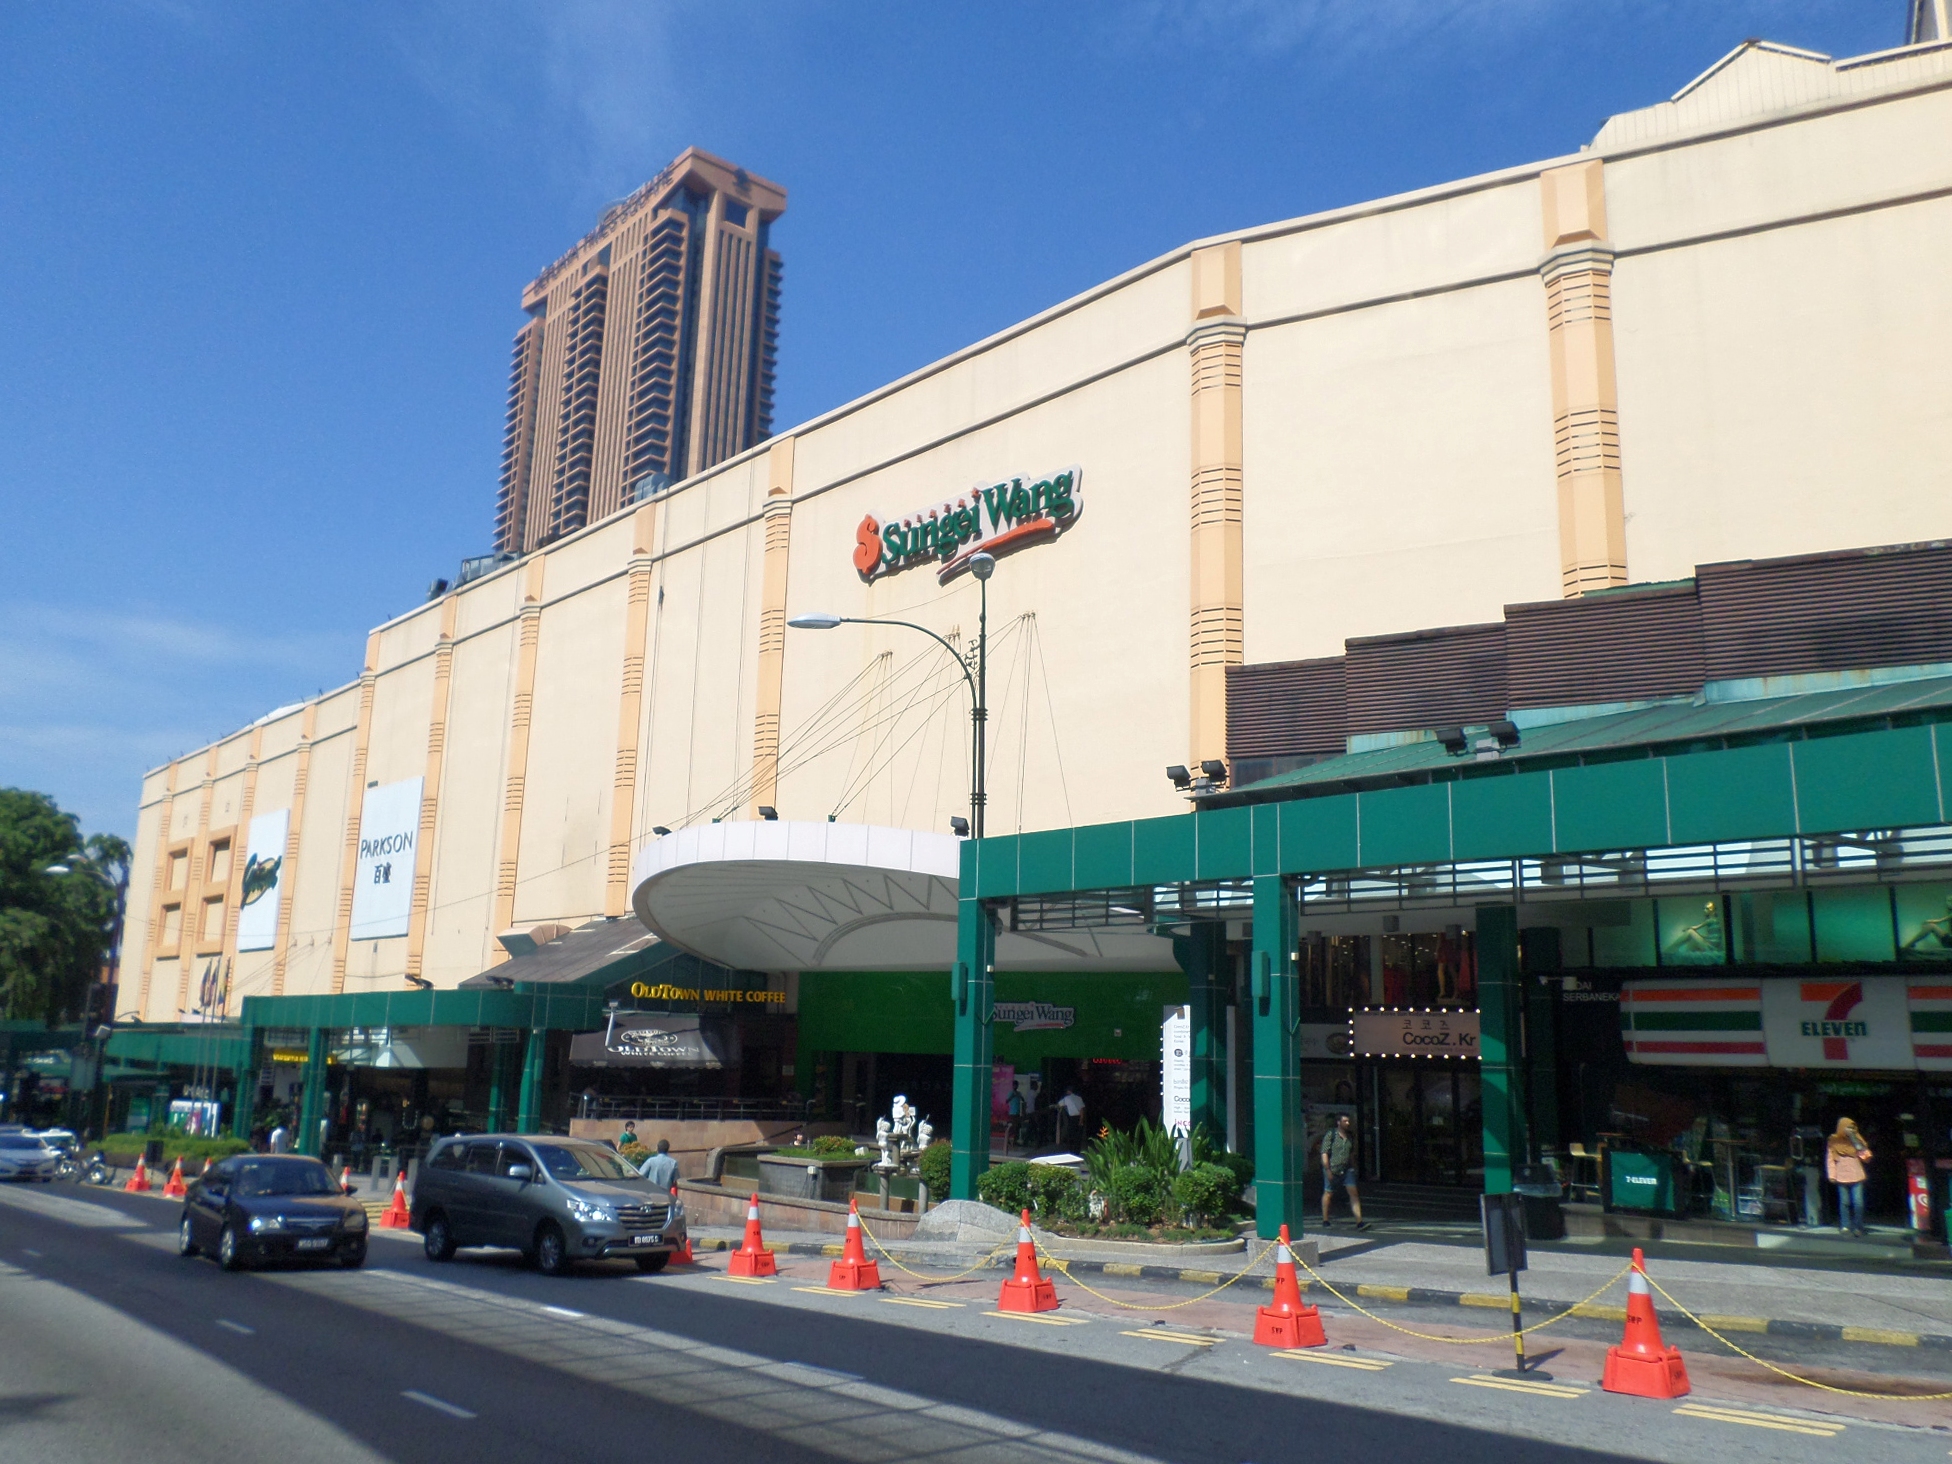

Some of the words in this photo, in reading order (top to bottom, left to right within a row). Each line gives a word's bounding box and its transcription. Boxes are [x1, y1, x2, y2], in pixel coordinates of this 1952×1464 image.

[881, 487, 982, 563] Sungei
[980, 470, 1075, 535] Wang
[360, 831, 413, 859] PARKSON
[703, 989, 743, 1002] WHITE
[745, 991, 786, 1003] COFFEE
[1034, 1005, 1073, 1025] Wang
